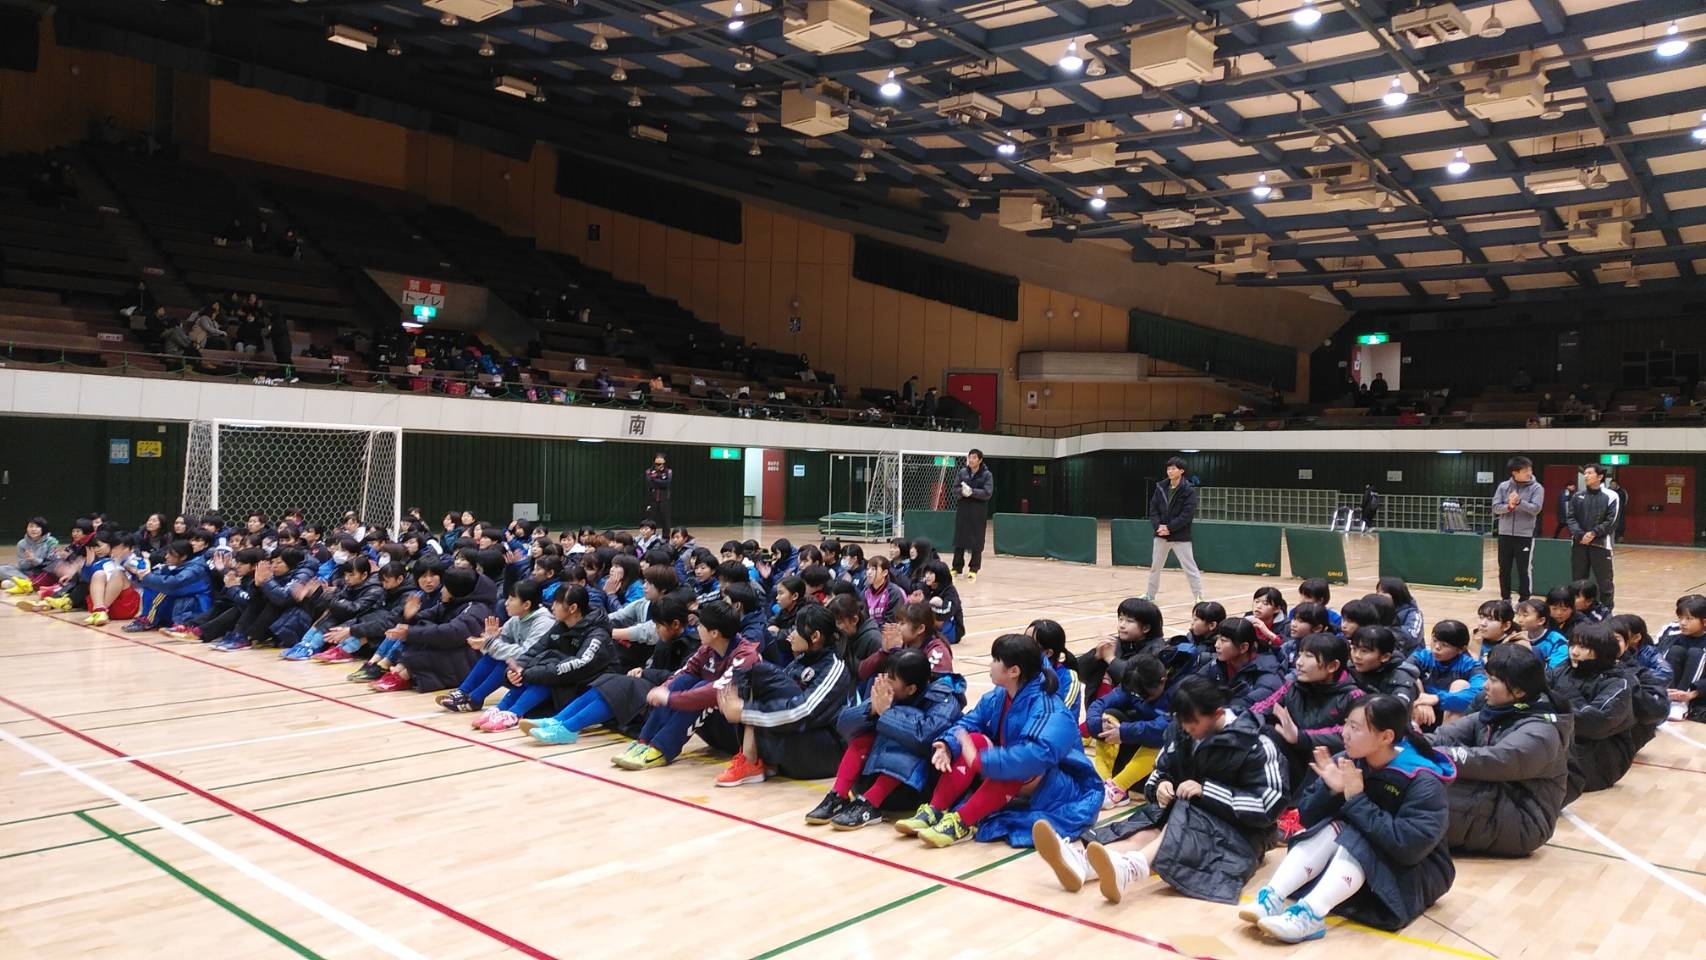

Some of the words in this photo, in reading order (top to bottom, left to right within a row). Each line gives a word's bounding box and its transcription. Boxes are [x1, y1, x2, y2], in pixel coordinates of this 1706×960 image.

[406, 292, 440, 306] トイレ
[629, 414, 647, 436] 南
[1607, 430, 1629, 447] 西
